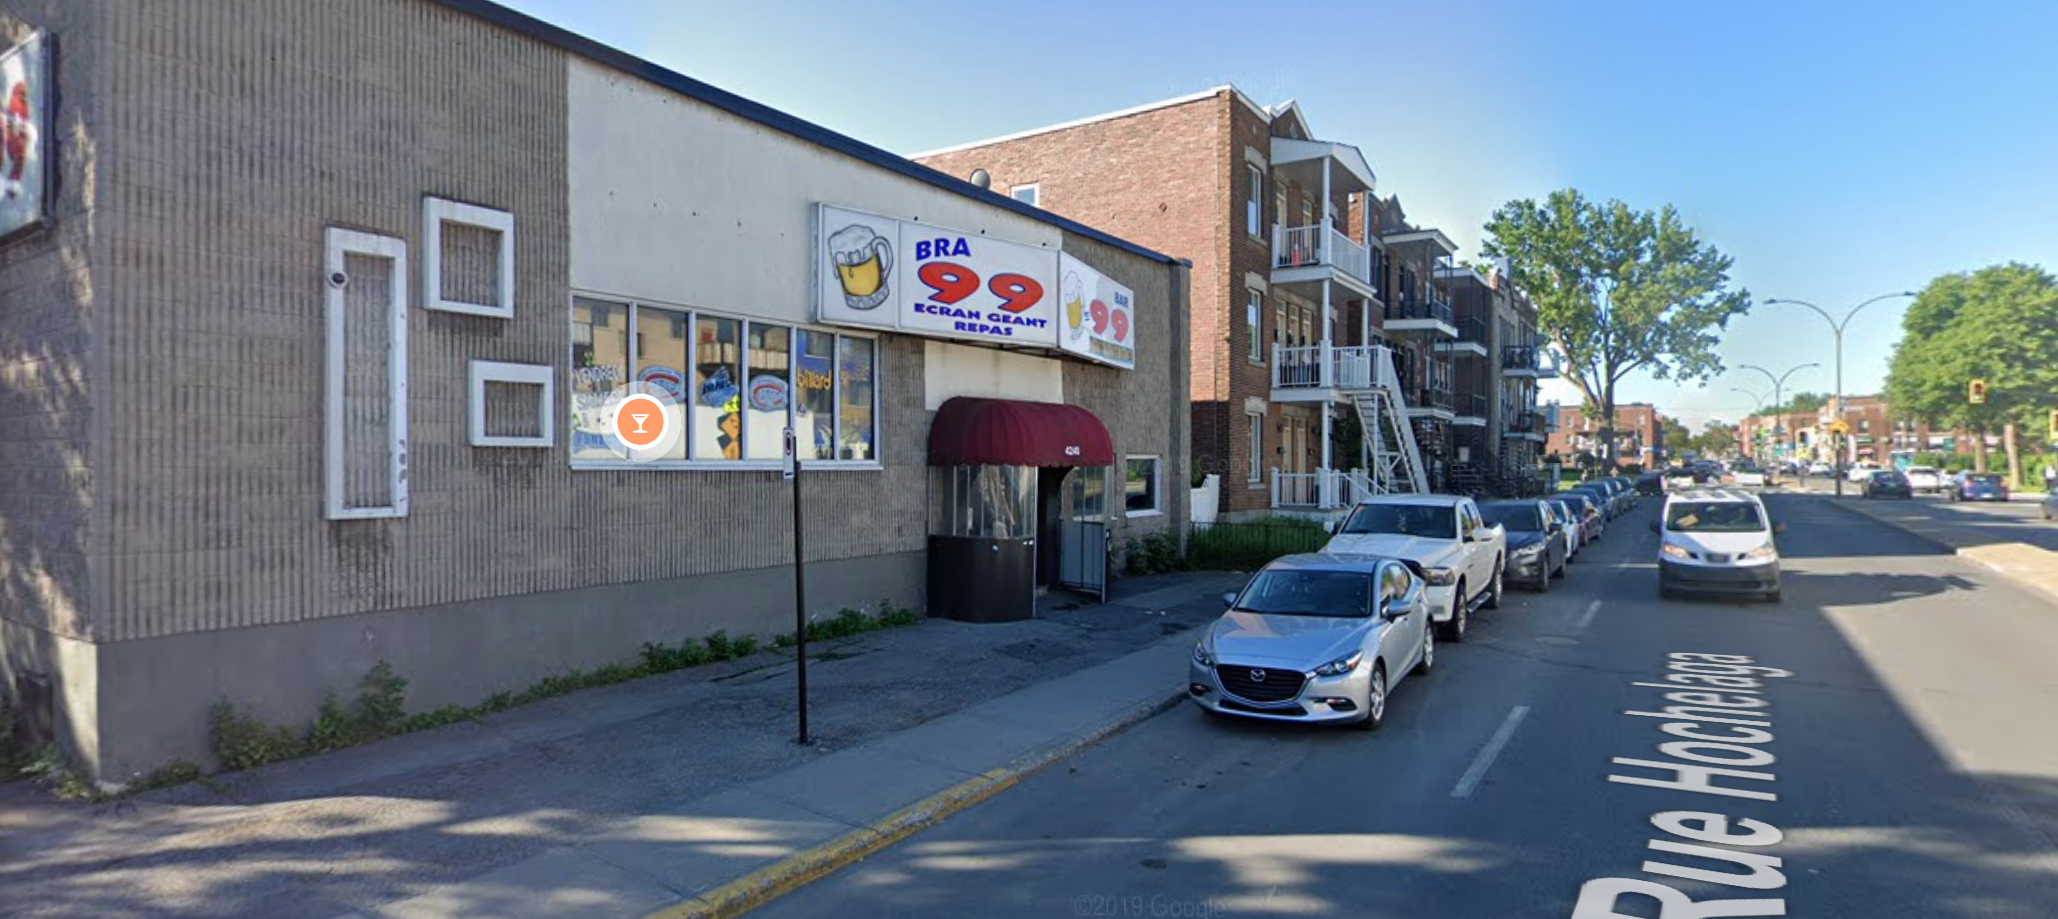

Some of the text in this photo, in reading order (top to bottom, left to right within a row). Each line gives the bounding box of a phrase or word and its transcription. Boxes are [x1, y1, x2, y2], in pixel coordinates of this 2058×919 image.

[916, 237, 971, 261] BRA
[917, 261, 1044, 314] 99
[1114, 291, 1129, 309] BAR
[914, 303, 1047, 328] ECRAN GEANT
[1090, 298, 1129, 342] 99
[954, 321, 1013, 336] REPAS
